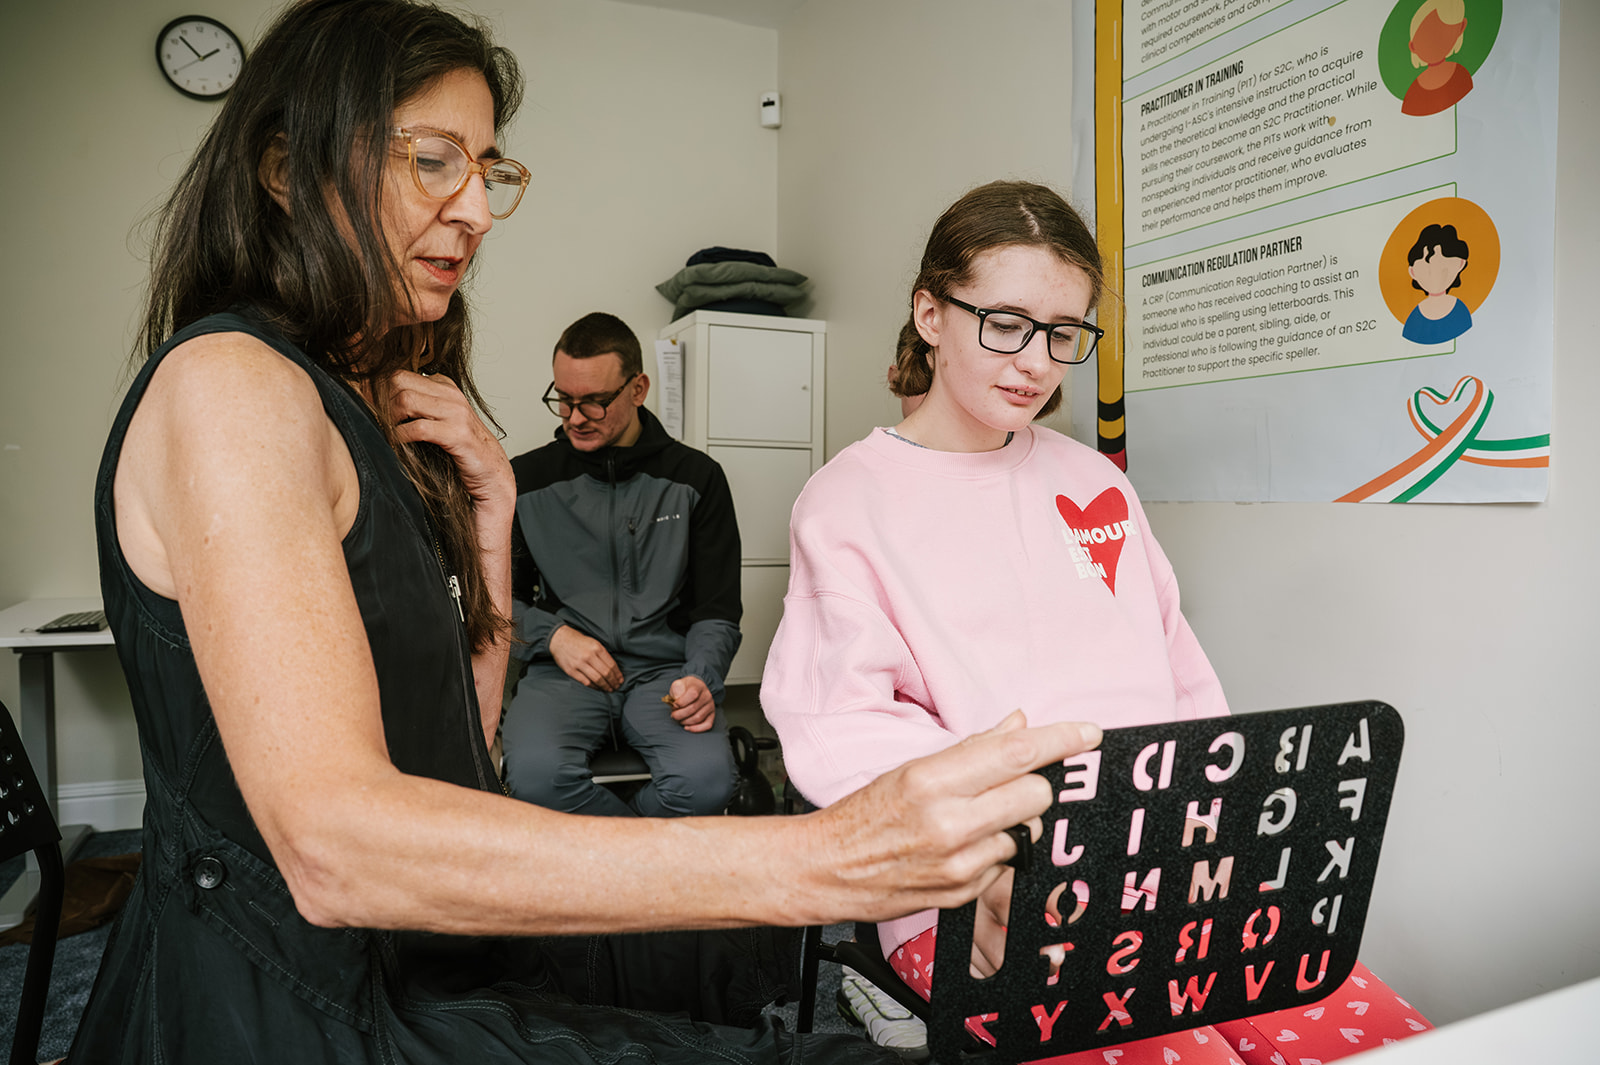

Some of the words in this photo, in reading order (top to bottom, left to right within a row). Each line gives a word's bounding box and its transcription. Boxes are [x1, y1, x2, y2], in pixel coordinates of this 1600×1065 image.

[1141, 22, 1156, 35] with
[1158, 9, 1180, 26] motor
[1141, 44, 1168, 62] clinical
[1168, 16, 1226, 49] competencies
[1227, 4, 1245, 20] and
[1141, 27, 1172, 49] required
[1140, 124, 1146, 132] A
[1147, 105, 1190, 130] Practitioner
[1192, 102, 1199, 112] in
[1202, 87, 1234, 106] Training
[1238, 74, 1257, 93] (PIT)
[1260, 70, 1272, 82] for
[1274, 61, 1294, 76] S2C,
[1296, 50, 1318, 66] who
[1320, 46, 1328, 56] is
[1140, 123, 1184, 146] undergoing
[1185, 110, 1214, 128] I-ASC's
[1216, 93, 1254, 116] intensive
[1256, 73, 1306, 99] instruction
[1308, 68, 1319, 78] to
[1322, 50, 1363, 73] acquire
[1140, 148, 1158, 161] both
[1160, 143, 1172, 154] the
[1174, 124, 1217, 147] theoretical
[1219, 106, 1266, 130] knowledge
[1268, 96, 1287, 111] and
[1289, 90, 1305, 103] the
[1308, 69, 1355, 99] practical
[1141, 83, 1193, 117] PRACTITIONER
[1195, 78, 1204, 93] IN
[1206, 60, 1244, 88] TRAINING
[1141, 162, 1158, 175] skills
[1160, 148, 1200, 168] necessary
[1201, 143, 1210, 153] to
[1212, 130, 1247, 149] become
[1249, 125, 1261, 135] an
[1263, 115, 1280, 130] S2C
[1284, 94, 1343, 122] Practitioner.
[1346, 81, 1378, 98] While
[1141, 172, 1174, 191] pursuing
[1176, 164, 1194, 177] their
[1195, 148, 1244, 170] coursework,
[1247, 140, 1261, 152] the
[1263, 133, 1281, 146] PITs
[1283, 124, 1306, 138] work
[1308, 114, 1330, 129] with
[1141, 182, 1190, 203] nonspeaking
[1192, 165, 1236, 186] individuals
[1238, 157, 1256, 171] and
[1258, 146, 1291, 164] receive
[1294, 129, 1343, 154] guidance
[1345, 119, 1372, 134] from
[1141, 209, 1151, 218] an
[1153, 192, 1200, 214] experienced
[1202, 182, 1232, 198] mentor
[1235, 164, 1289, 190] practitioner,
[1291, 156, 1311, 170] who
[1314, 138, 1367, 162] evaluates
[1142, 220, 1158, 232] their
[1160, 204, 1211, 229] performance
[1213, 198, 1230, 210] and
[1232, 191, 1256, 204] helps
[1258, 183, 1282, 197] them
[1284, 169, 1327, 188] improve.
[1142, 260, 1205, 288] COMMUNICATION
[1207, 247, 1258, 272] REGULATION
[1260, 236, 1302, 260] PARTNER
[1149, 294, 1164, 305] CRP
[1166, 278, 1234, 302] (Communication
[1236, 268, 1285, 286] Regulation
[1288, 255, 1326, 274] Partner)
[1330, 255, 1338, 265] is
[1142, 307, 1177, 320] someone
[1180, 303, 1195, 313] who
[1198, 299, 1212, 310] has
[1214, 290, 1251, 306] received
[1254, 282, 1298, 298] coaching
[1301, 279, 1310, 289] to
[1313, 272, 1342, 286] assist
[1345, 269, 1359, 280] an
[1143, 321, 1178, 335] individual
[1181, 318, 1197, 328] who
[1199, 316, 1205, 325] is
[1208, 310, 1240, 325] spelling
[1242, 305, 1266, 316] using
[1269, 293, 1331, 312] letterboards.
[1334, 287, 1354, 300] This
[1143, 336, 1179, 349] individual
[1181, 332, 1203, 343] could
[1205, 329, 1216, 339] be
[1226, 324, 1257, 338] parent,
[1260, 318, 1291, 330] sibling,
[1294, 313, 1318, 324] aide,
[1320, 311, 1331, 320] or
[1143, 349, 1189, 366] professional
[1191, 346, 1208, 357] who
[1210, 345, 1216, 354] is
[1218, 340, 1257, 353] following
[1260, 337, 1274, 346] the
[1277, 330, 1323, 347] guidance
[1326, 325, 1337, 337] of
[1339, 325, 1352, 335] an
[1356, 320, 1376, 332] S2C
[1143, 365, 1185, 378] Practitioner
[1188, 364, 1196, 372] to
[1198, 359, 1229, 373] support
[1232, 357, 1245, 367] the
[1248, 352, 1283, 366] specific
[1286, 347, 1320, 361] speller.
[1075, 562, 1108, 579] BON
